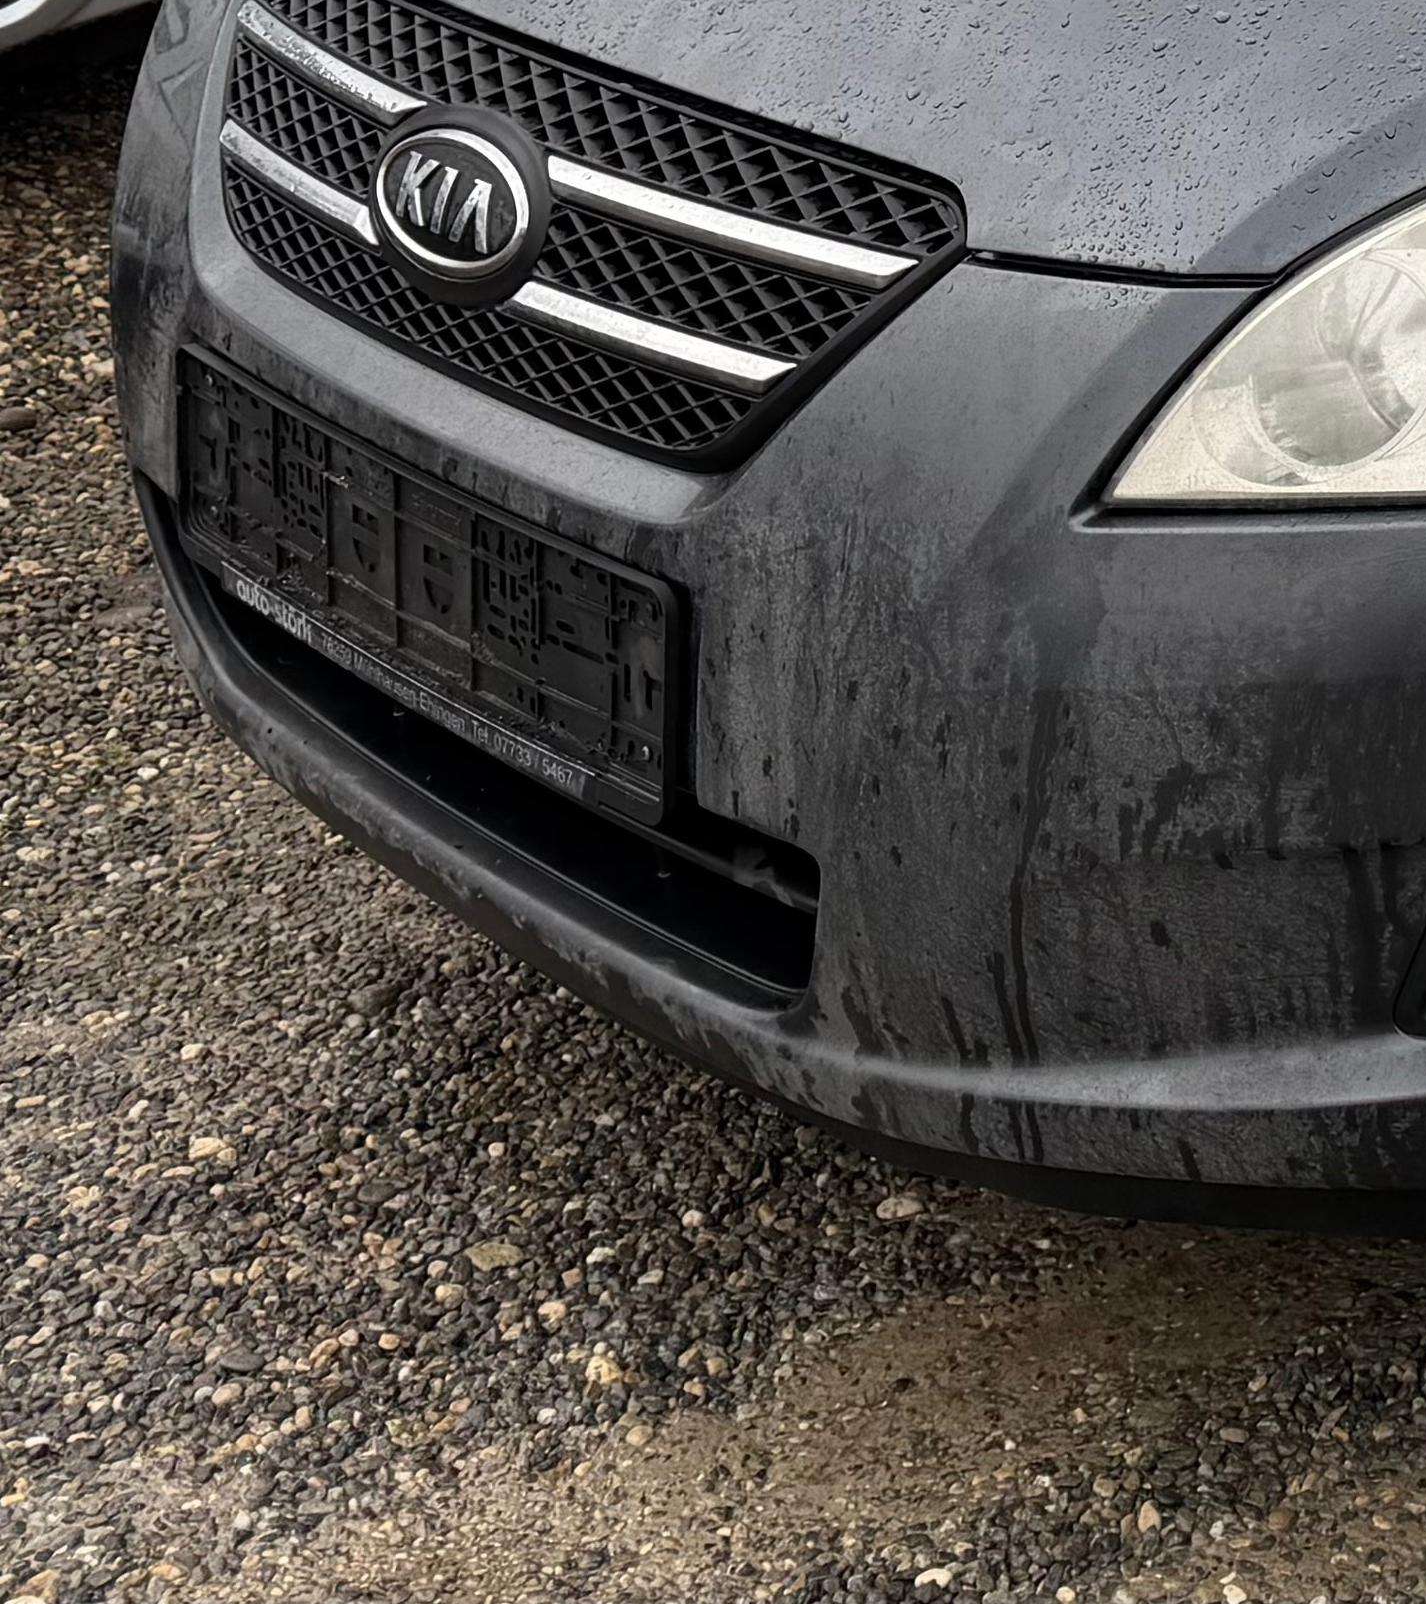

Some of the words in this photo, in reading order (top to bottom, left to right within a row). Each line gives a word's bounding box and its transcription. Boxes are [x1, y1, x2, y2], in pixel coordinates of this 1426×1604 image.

[395, 150, 493, 255] KIA
[494, 734, 531, 767] 07733
[542, 757, 573, 786] 5467
